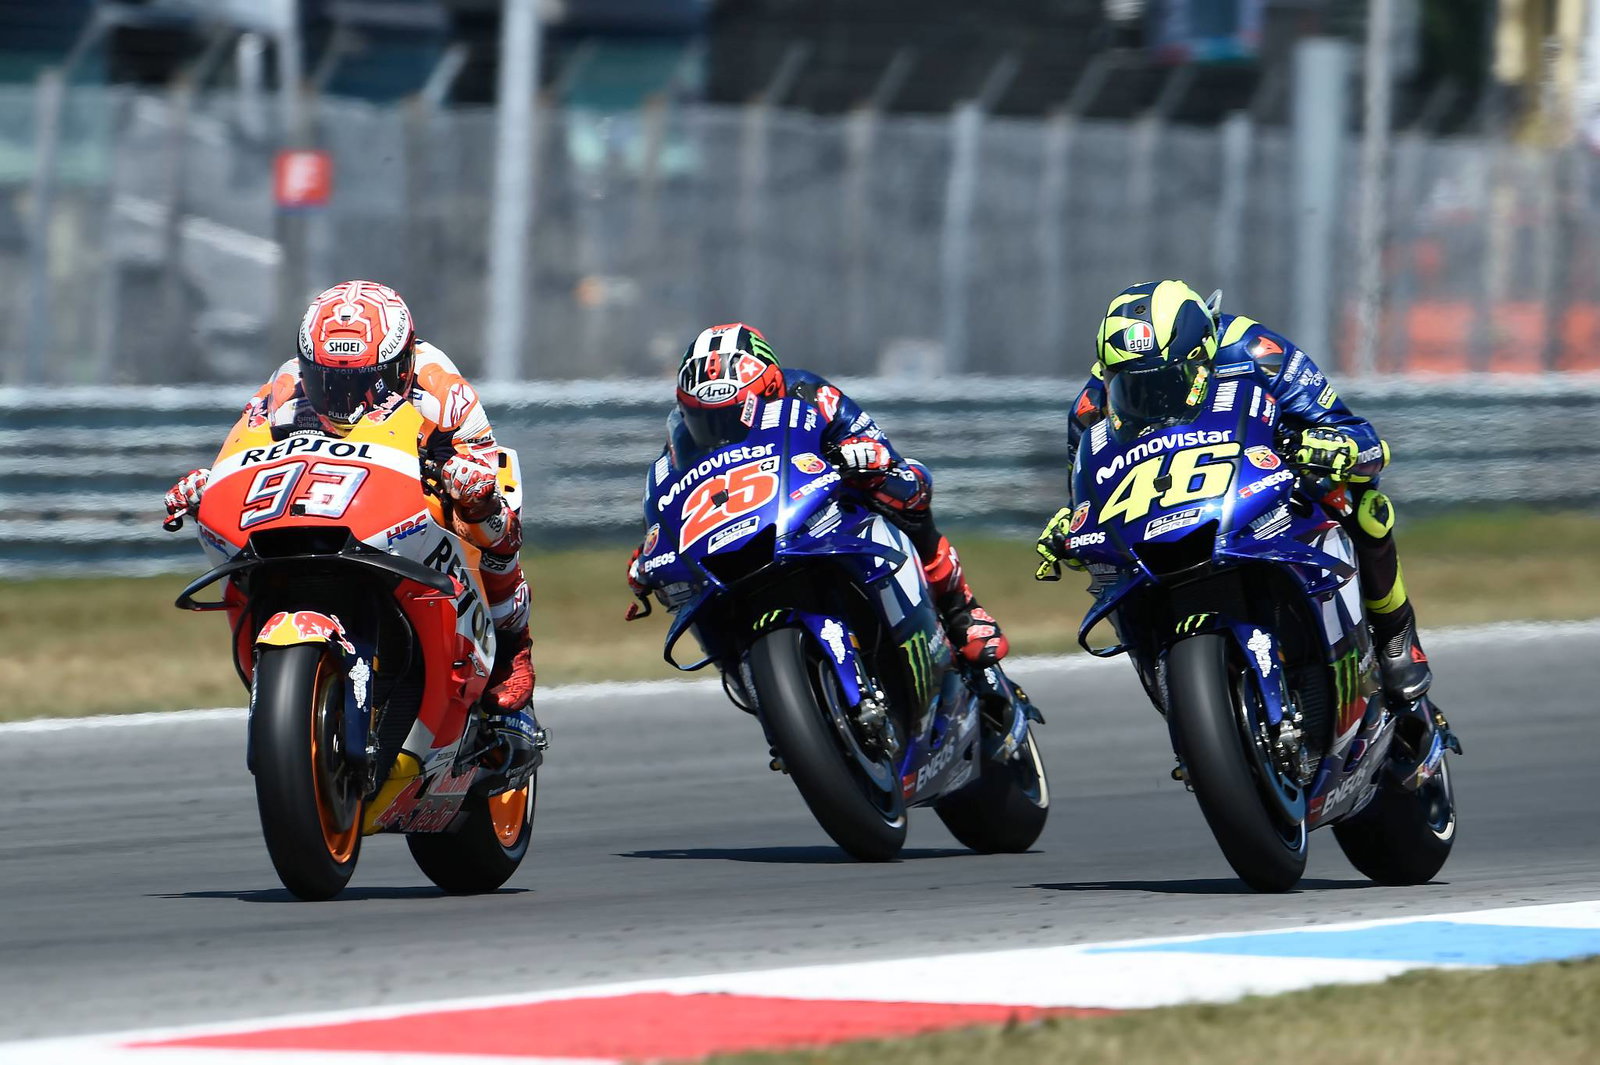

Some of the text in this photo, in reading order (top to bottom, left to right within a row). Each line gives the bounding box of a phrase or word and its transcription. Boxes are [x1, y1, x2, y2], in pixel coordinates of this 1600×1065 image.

[329, 341, 359, 352] SHOEI
[381, 311, 405, 359] PULL&BEAR
[359, 364, 387, 373] WINGS
[699, 385, 732, 398] Arai
[289, 430, 325, 438] HONDA
[1125, 430, 1232, 465] movistar
[241, 437, 373, 467] REPSOL
[680, 443, 776, 489] movistar
[239, 460, 370, 531] 93
[799, 471, 841, 496] ENEOS
[1097, 442, 1242, 525] 46
[1250, 469, 1294, 495] ENEOS
[679, 455, 781, 554] 25
[386, 514, 428, 547] HRC
[1070, 531, 1106, 549] ENEOS
[644, 551, 677, 573] ENEOS
